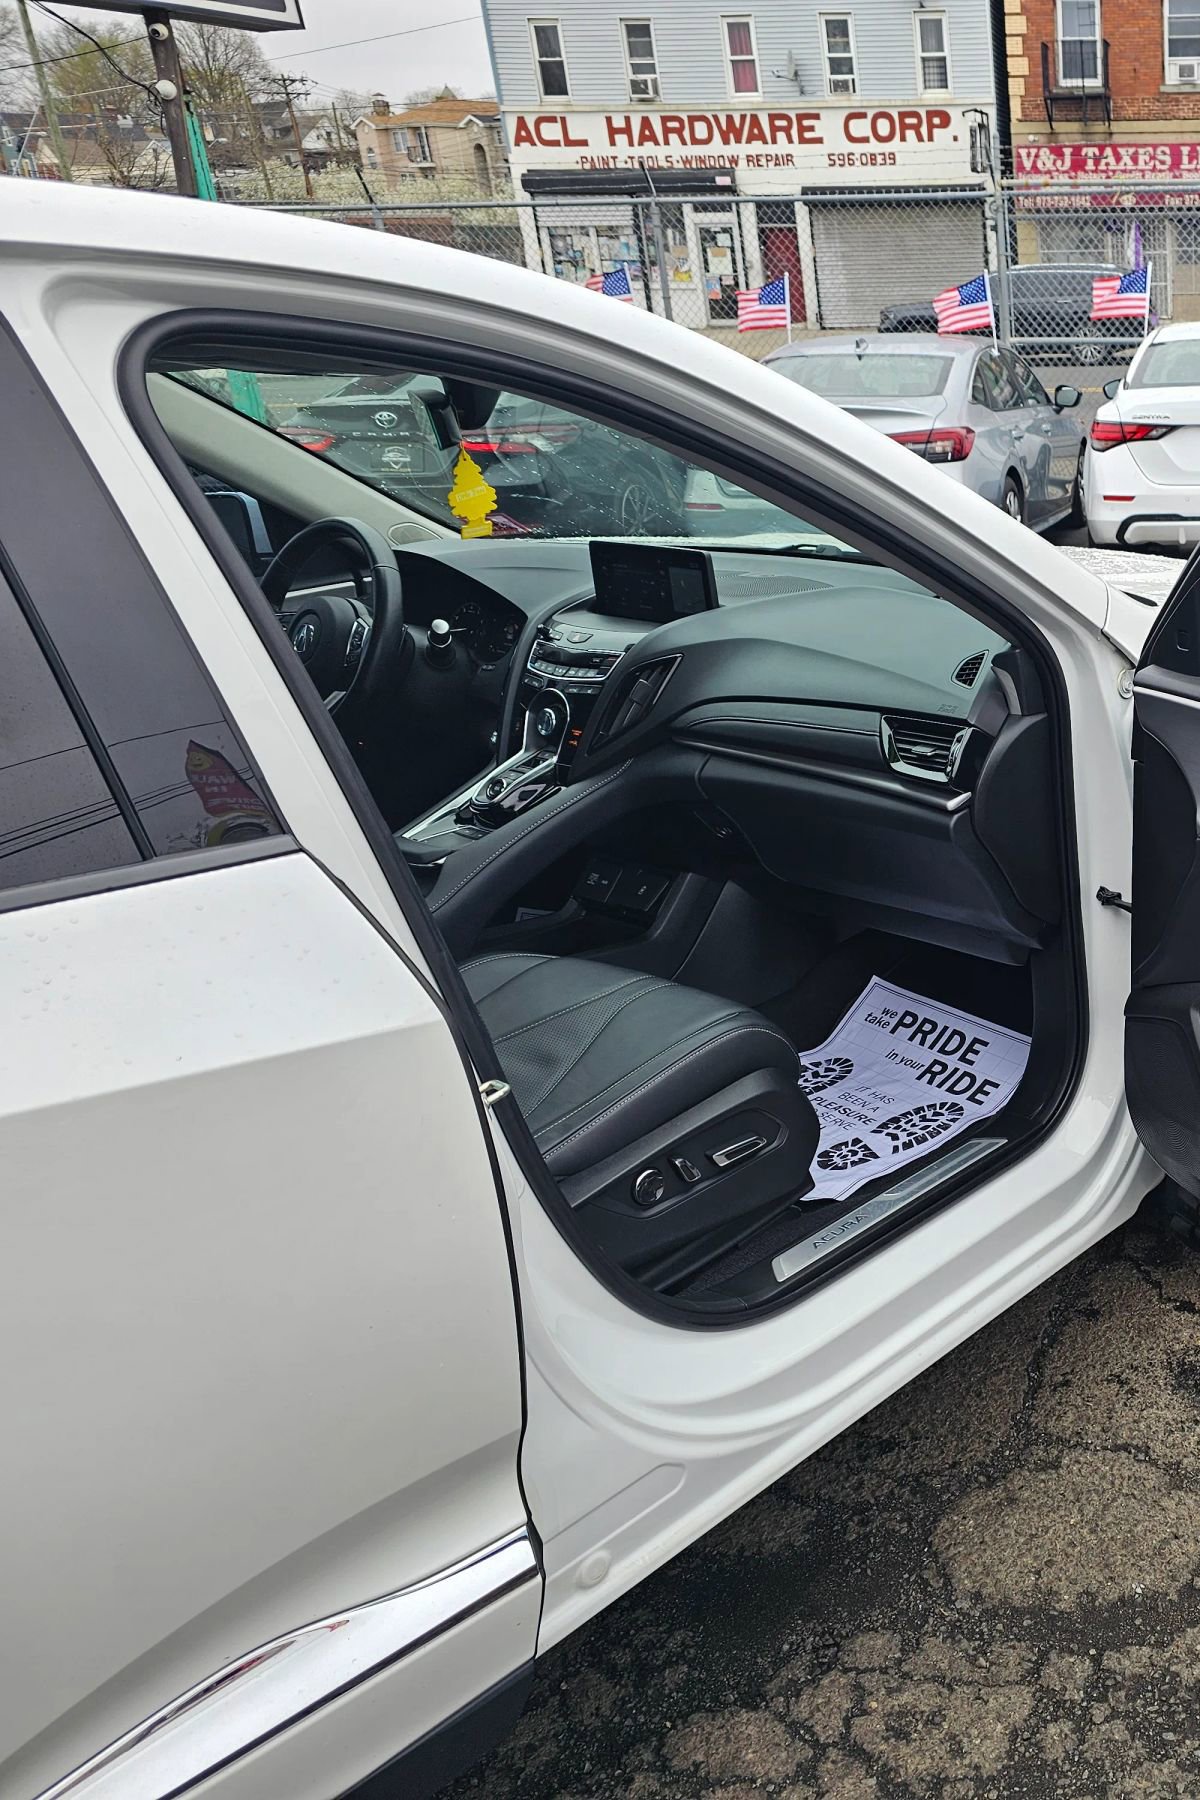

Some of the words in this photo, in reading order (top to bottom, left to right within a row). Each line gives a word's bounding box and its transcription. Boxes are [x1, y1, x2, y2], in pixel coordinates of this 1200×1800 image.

[513, 115, 589, 147] ACL
[604, 112, 824, 147] HARDWARE
[843, 109, 959, 144] CORP.
[746, 153, 795, 168] REPAIR
[1018, 147, 1073, 171] V&J
[1081, 146, 1171, 170] TAXES
[881, 1007, 899, 1019] we
[864, 1012, 891, 1029] take
[889, 1009, 990, 1067] PRIDE
[885, 1048, 899, 1060] in
[895, 1055, 926, 1071] your
[915, 1058, 1001, 1106] RIDE
[837, 1091, 872, 1108] BEEN
[855, 1085, 871, 1093] IT
[868, 1091, 895, 1105] HAS
[810, 1096, 878, 1126] PLEASURE
[818, 1112, 856, 1131] SERVE
[812, 1213, 870, 1249] ACURA
